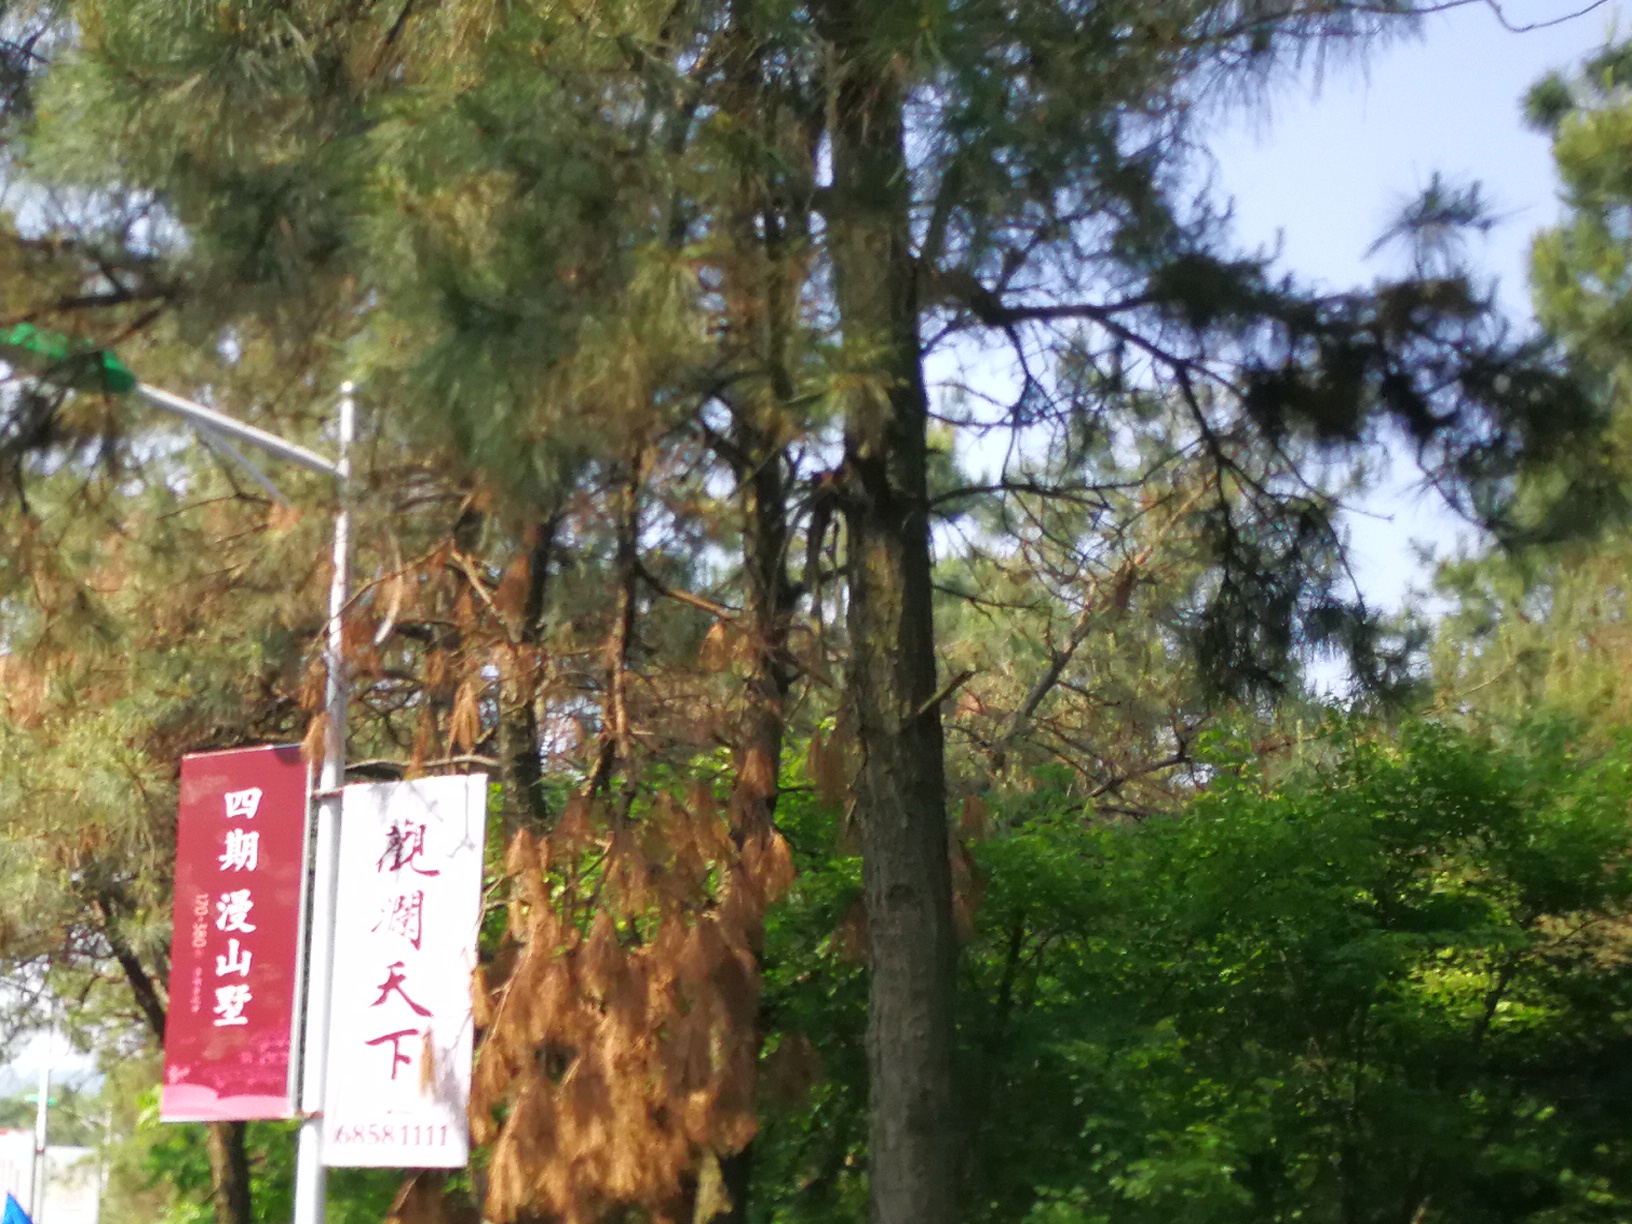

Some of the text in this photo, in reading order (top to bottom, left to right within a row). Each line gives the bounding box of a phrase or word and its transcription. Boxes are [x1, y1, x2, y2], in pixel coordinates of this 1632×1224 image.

[213, 787, 263, 1027] 四期漫山墅
[333, 1122, 448, 1147] 68581111
